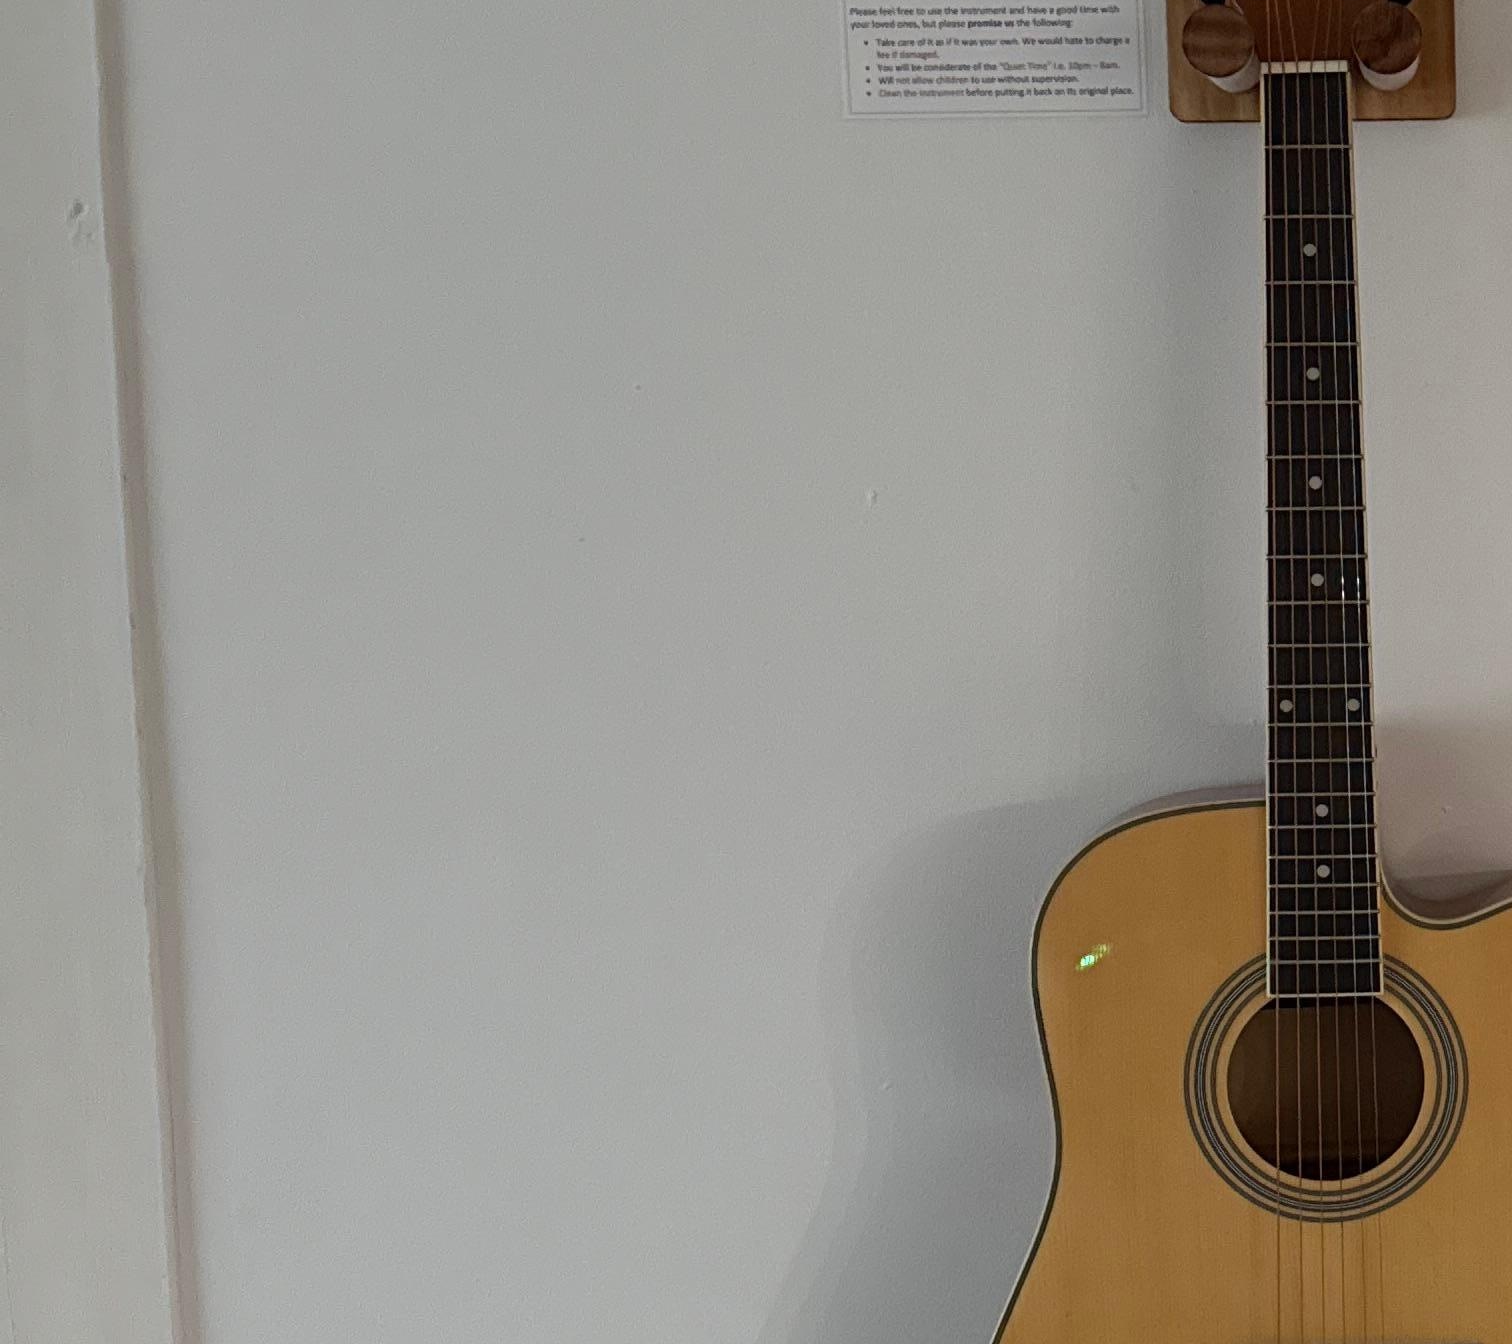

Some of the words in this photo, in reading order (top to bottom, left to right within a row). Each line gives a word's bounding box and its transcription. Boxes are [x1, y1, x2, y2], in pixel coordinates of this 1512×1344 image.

[849, 7, 877, 16] Please
[879, 7, 896, 15] feel
[897, 7, 914, 15] free
[916, 7, 926, 15] to
[944, 6, 958, 15] the
[960, 6, 1006, 15] instrument
[1009, 6, 1025, 14] and
[1027, 6, 1047, 14] have
[1056, 5, 1077, 16] good
[1080, 5, 1098, 13] time
[1100, 5, 1120, 13] with
[850, 21, 870, 31] your
[872, 20, 895, 28] loved
[922, 19, 936, 28] but
[938, 20, 966, 30] please
[967, 19, 1002, 29] promise
[1016, 18, 1030, 27] the
[876, 38, 895, 46] Take
[917, 37, 926, 46] of
[980, 39, 997, 47] your
[1022, 37, 1036, 45] We
[1038, 36, 1062, 45] would
[1064, 37, 1083, 45] hate
[1085, 37, 1094, 45] to
[1095, 36, 1122, 47] charge
[879, 76, 894, 84] Will
[896, 76, 910, 84] not
[911, 76, 933, 84] allow
[936, 75, 968, 84] children
[971, 76, 980, 84] to
[998, 75, 1029, 84] without
[879, 89, 901, 97] Clean
[903, 89, 917, 97] the
[920, 88, 964, 96] instrument
[965, 88, 993, 96] before
[995, 88, 1024, 97] putting
[1033, 87, 1052, 95] back
[1066, 87, 1077, 95] its
[1079, 86, 1108, 97] original
